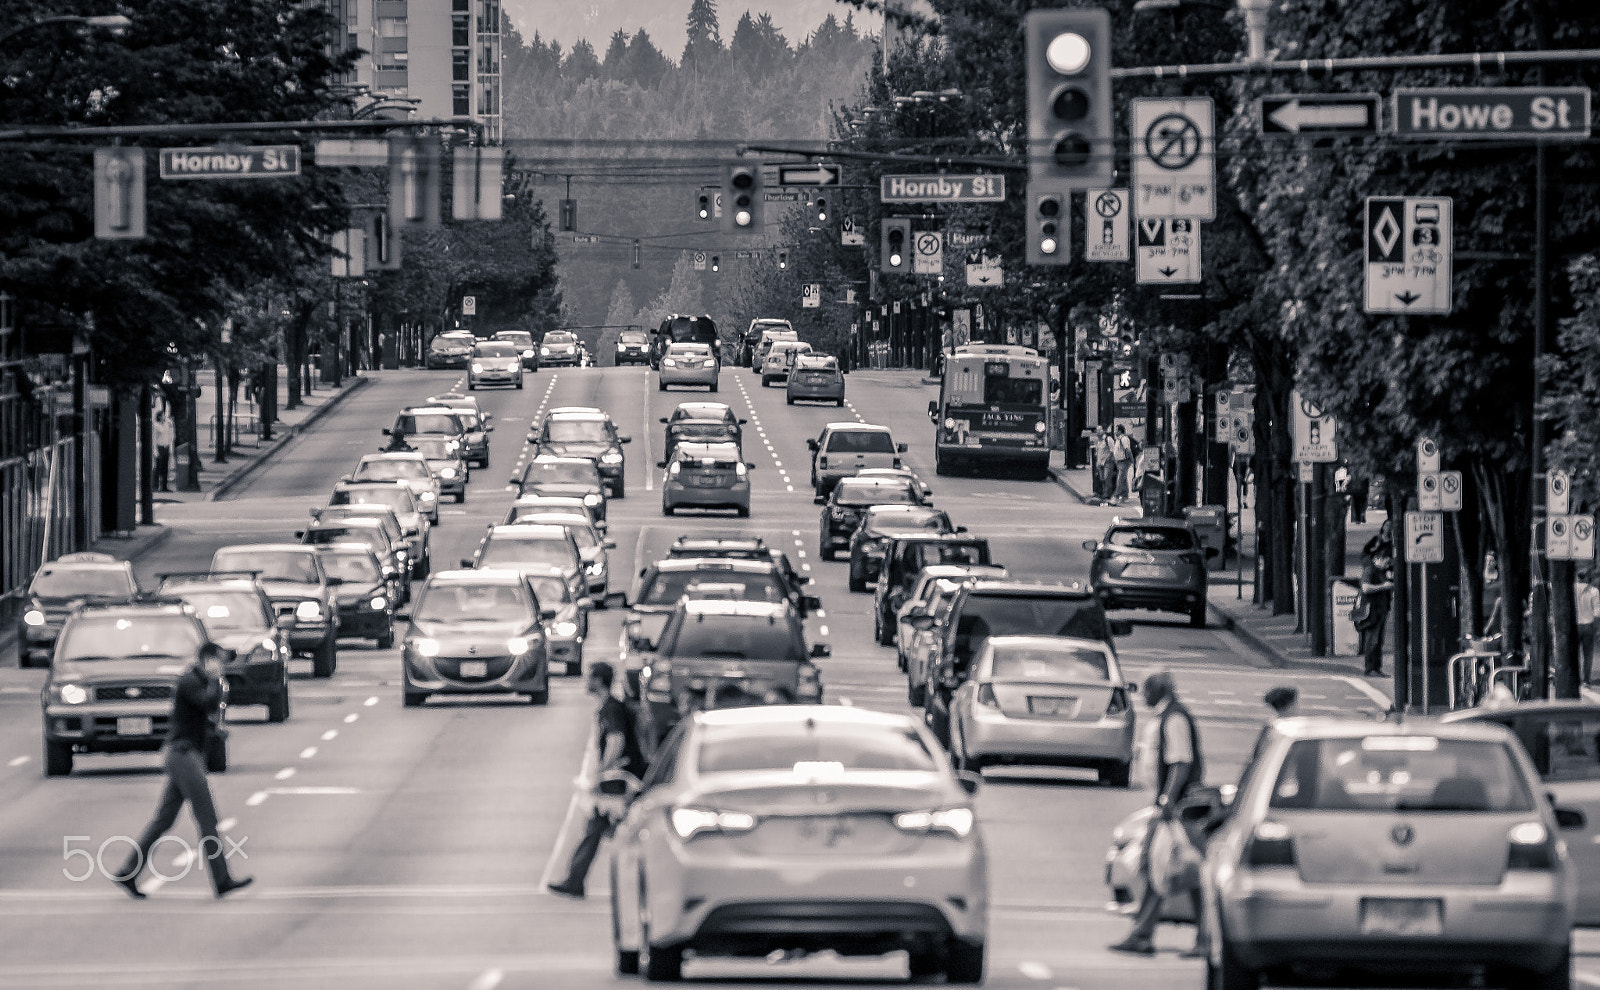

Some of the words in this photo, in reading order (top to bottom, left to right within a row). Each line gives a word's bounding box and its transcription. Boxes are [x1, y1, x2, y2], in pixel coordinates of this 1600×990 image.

[1411, 97, 1514, 130] Howe
[1530, 96, 1571, 130] St
[172, 152, 252, 173] Hornby
[263, 149, 288, 170] St
[891, 178, 963, 199] Hornby
[972, 176, 995, 195] St
